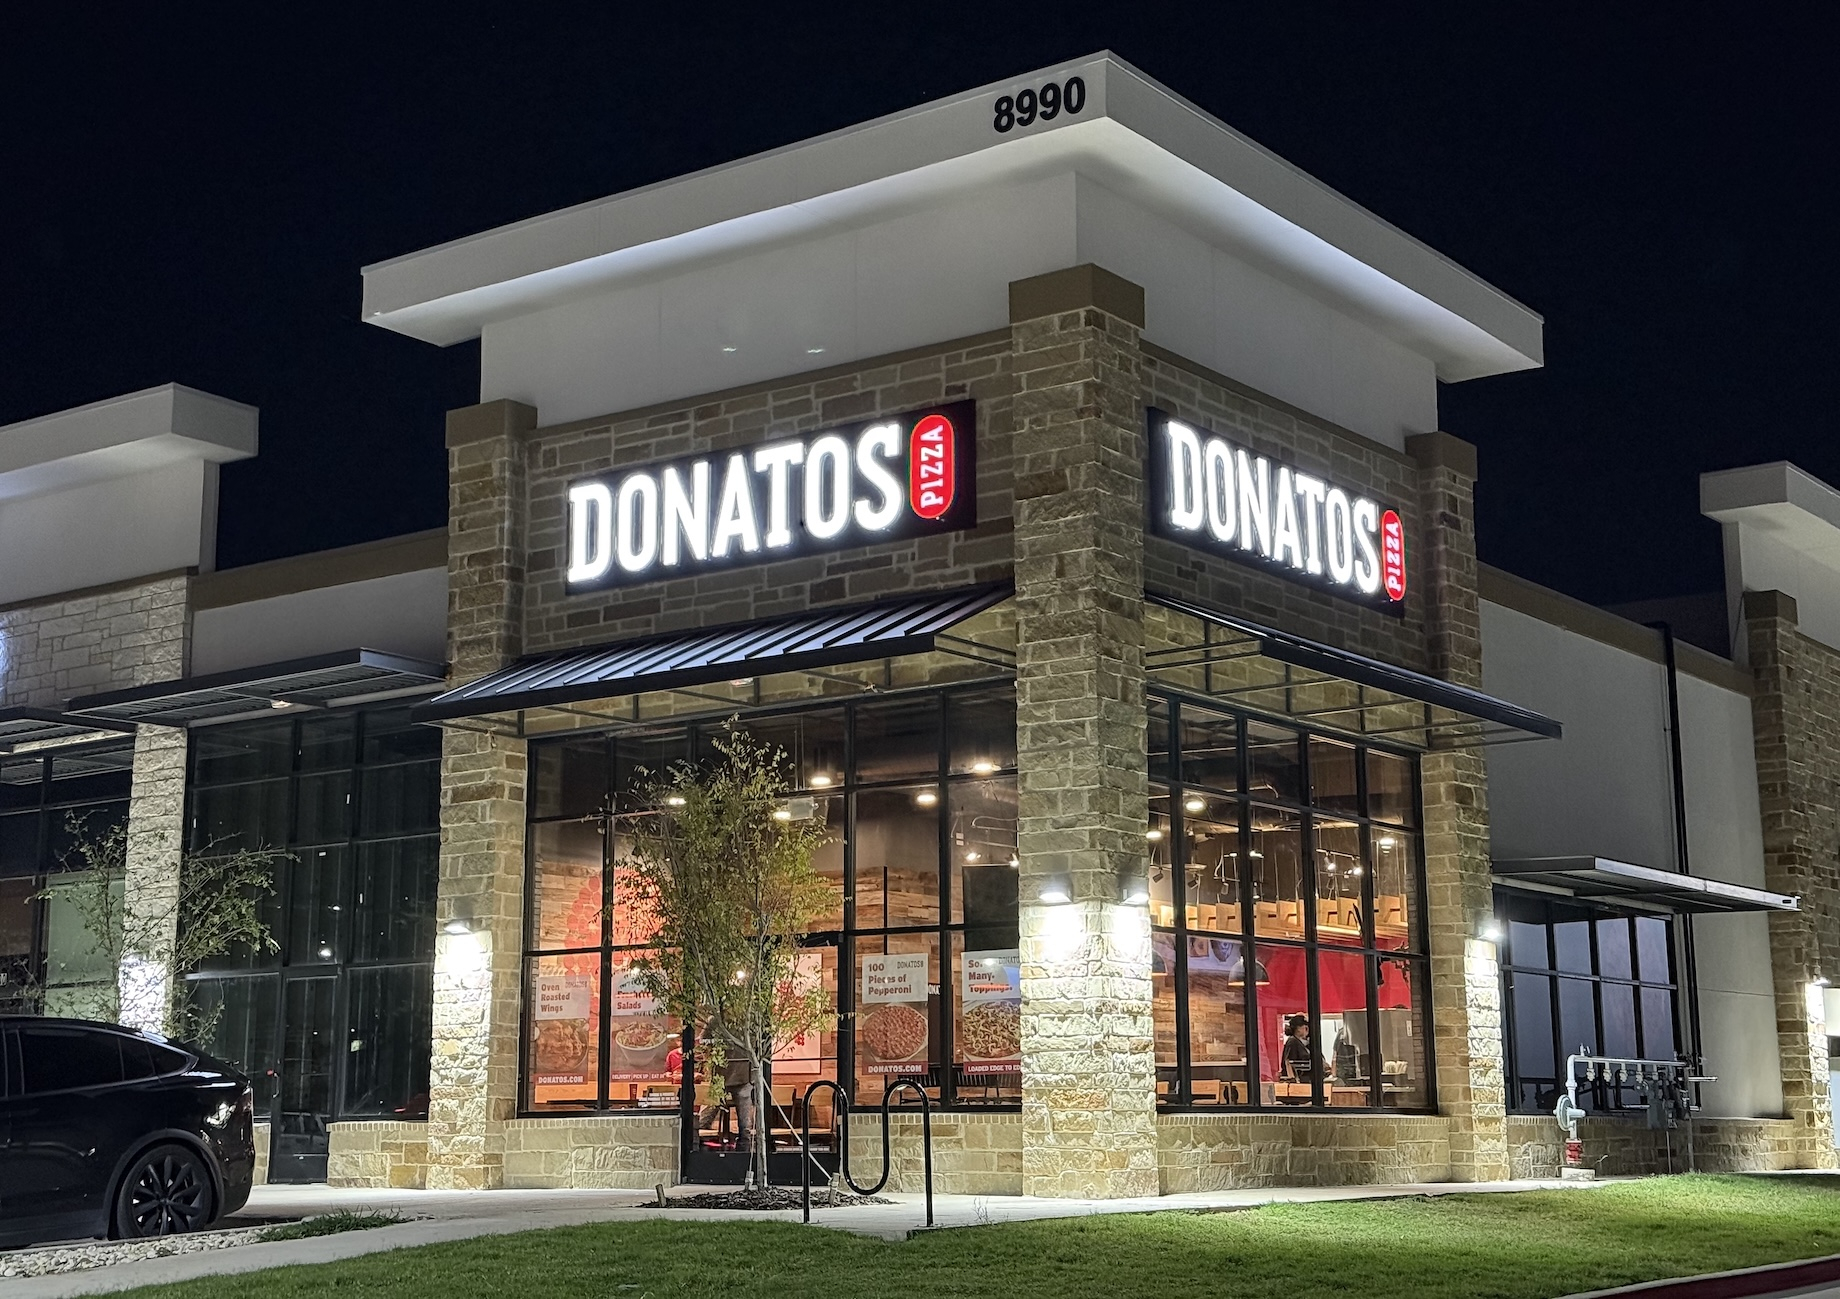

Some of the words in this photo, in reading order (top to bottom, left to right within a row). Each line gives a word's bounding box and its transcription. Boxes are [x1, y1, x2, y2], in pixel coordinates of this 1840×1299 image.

[993, 76, 1086, 133] 8990
[920, 424, 944, 508] PIZZA
[567, 422, 904, 584] DONATOS
[1164, 420, 1382, 594] DONATOS
[1385, 521, 1402, 592] PIZZA
[868, 963, 885, 972] 100
[868, 975, 896, 984] Pieces
[897, 974, 907, 983] of
[968, 972, 995, 981] Many.
[868, 985, 912, 996] Pepperoni
[541, 993, 571, 1002] Roasted
[541, 1004, 563, 1013] Wings
[617, 1001, 641, 1010] Salads
[868, 1065, 922, 1073] DONATOS.COM
[538, 1076, 584, 1084] DONATOS.COM
